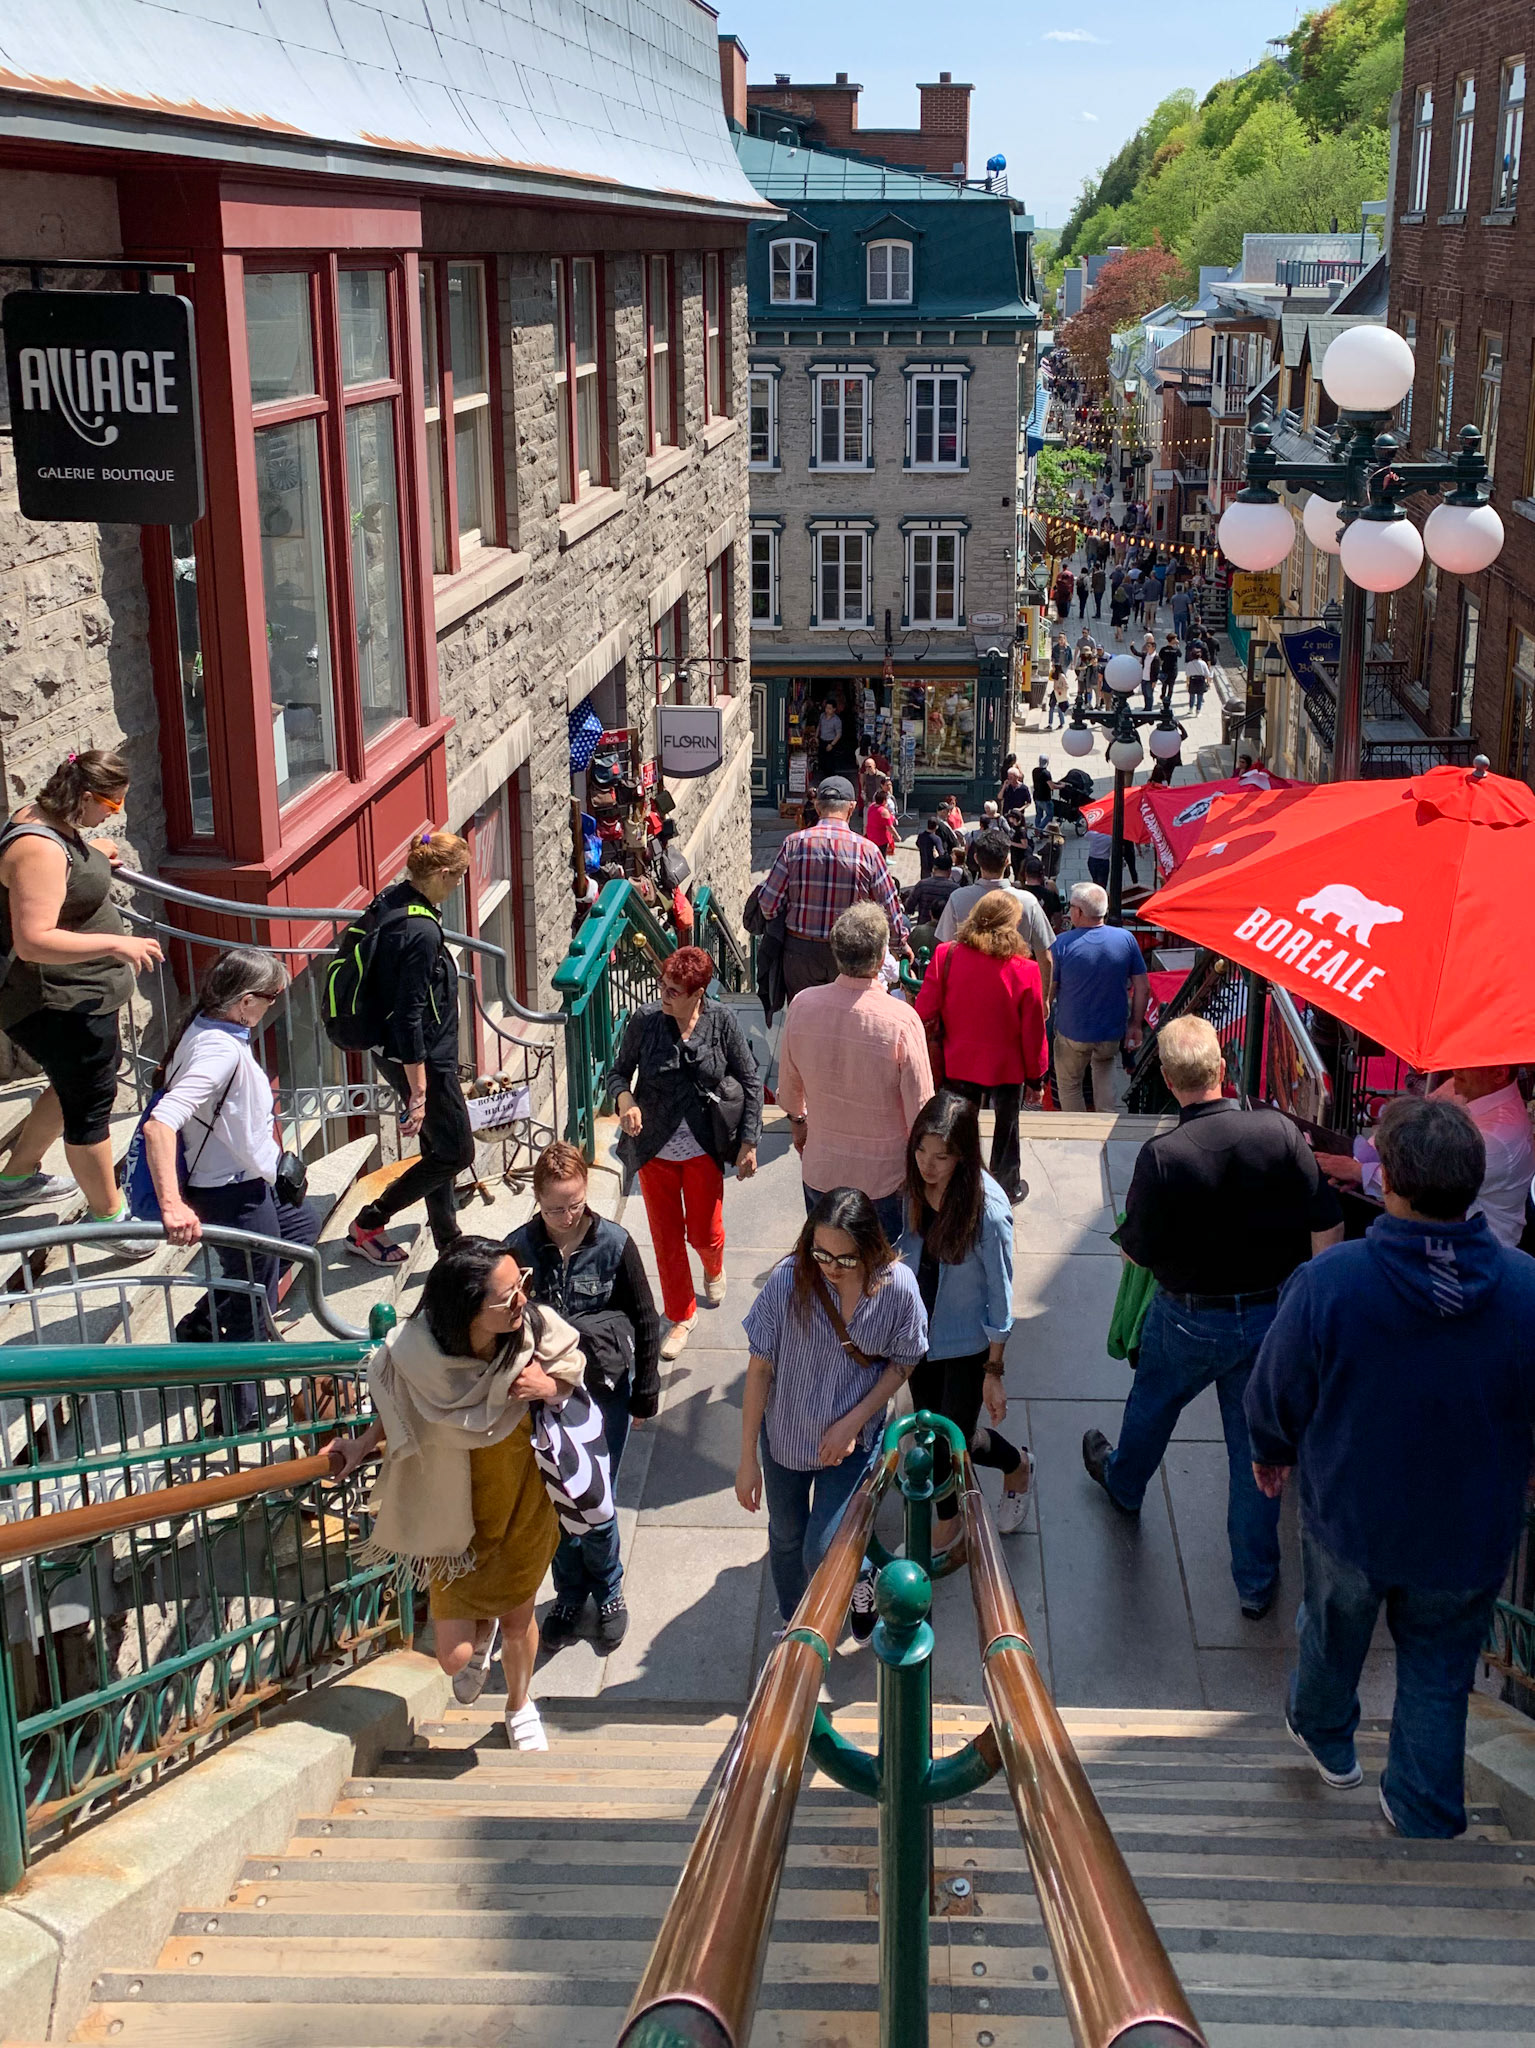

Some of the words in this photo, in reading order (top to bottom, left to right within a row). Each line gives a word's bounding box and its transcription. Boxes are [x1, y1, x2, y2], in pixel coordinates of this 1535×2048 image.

[37, 466, 95, 480] GALERIE
[101, 468, 175, 482] BOUTIQUE
[1302, 640, 1313, 649] Le
[1316, 640, 1334, 650] pub
[663, 735, 717, 749] FLORIN
[1233, 906, 1386, 1002] BORÉALE
[478, 1091, 518, 1106] BONJOUR
[485, 1103, 514, 1116] HELLO
